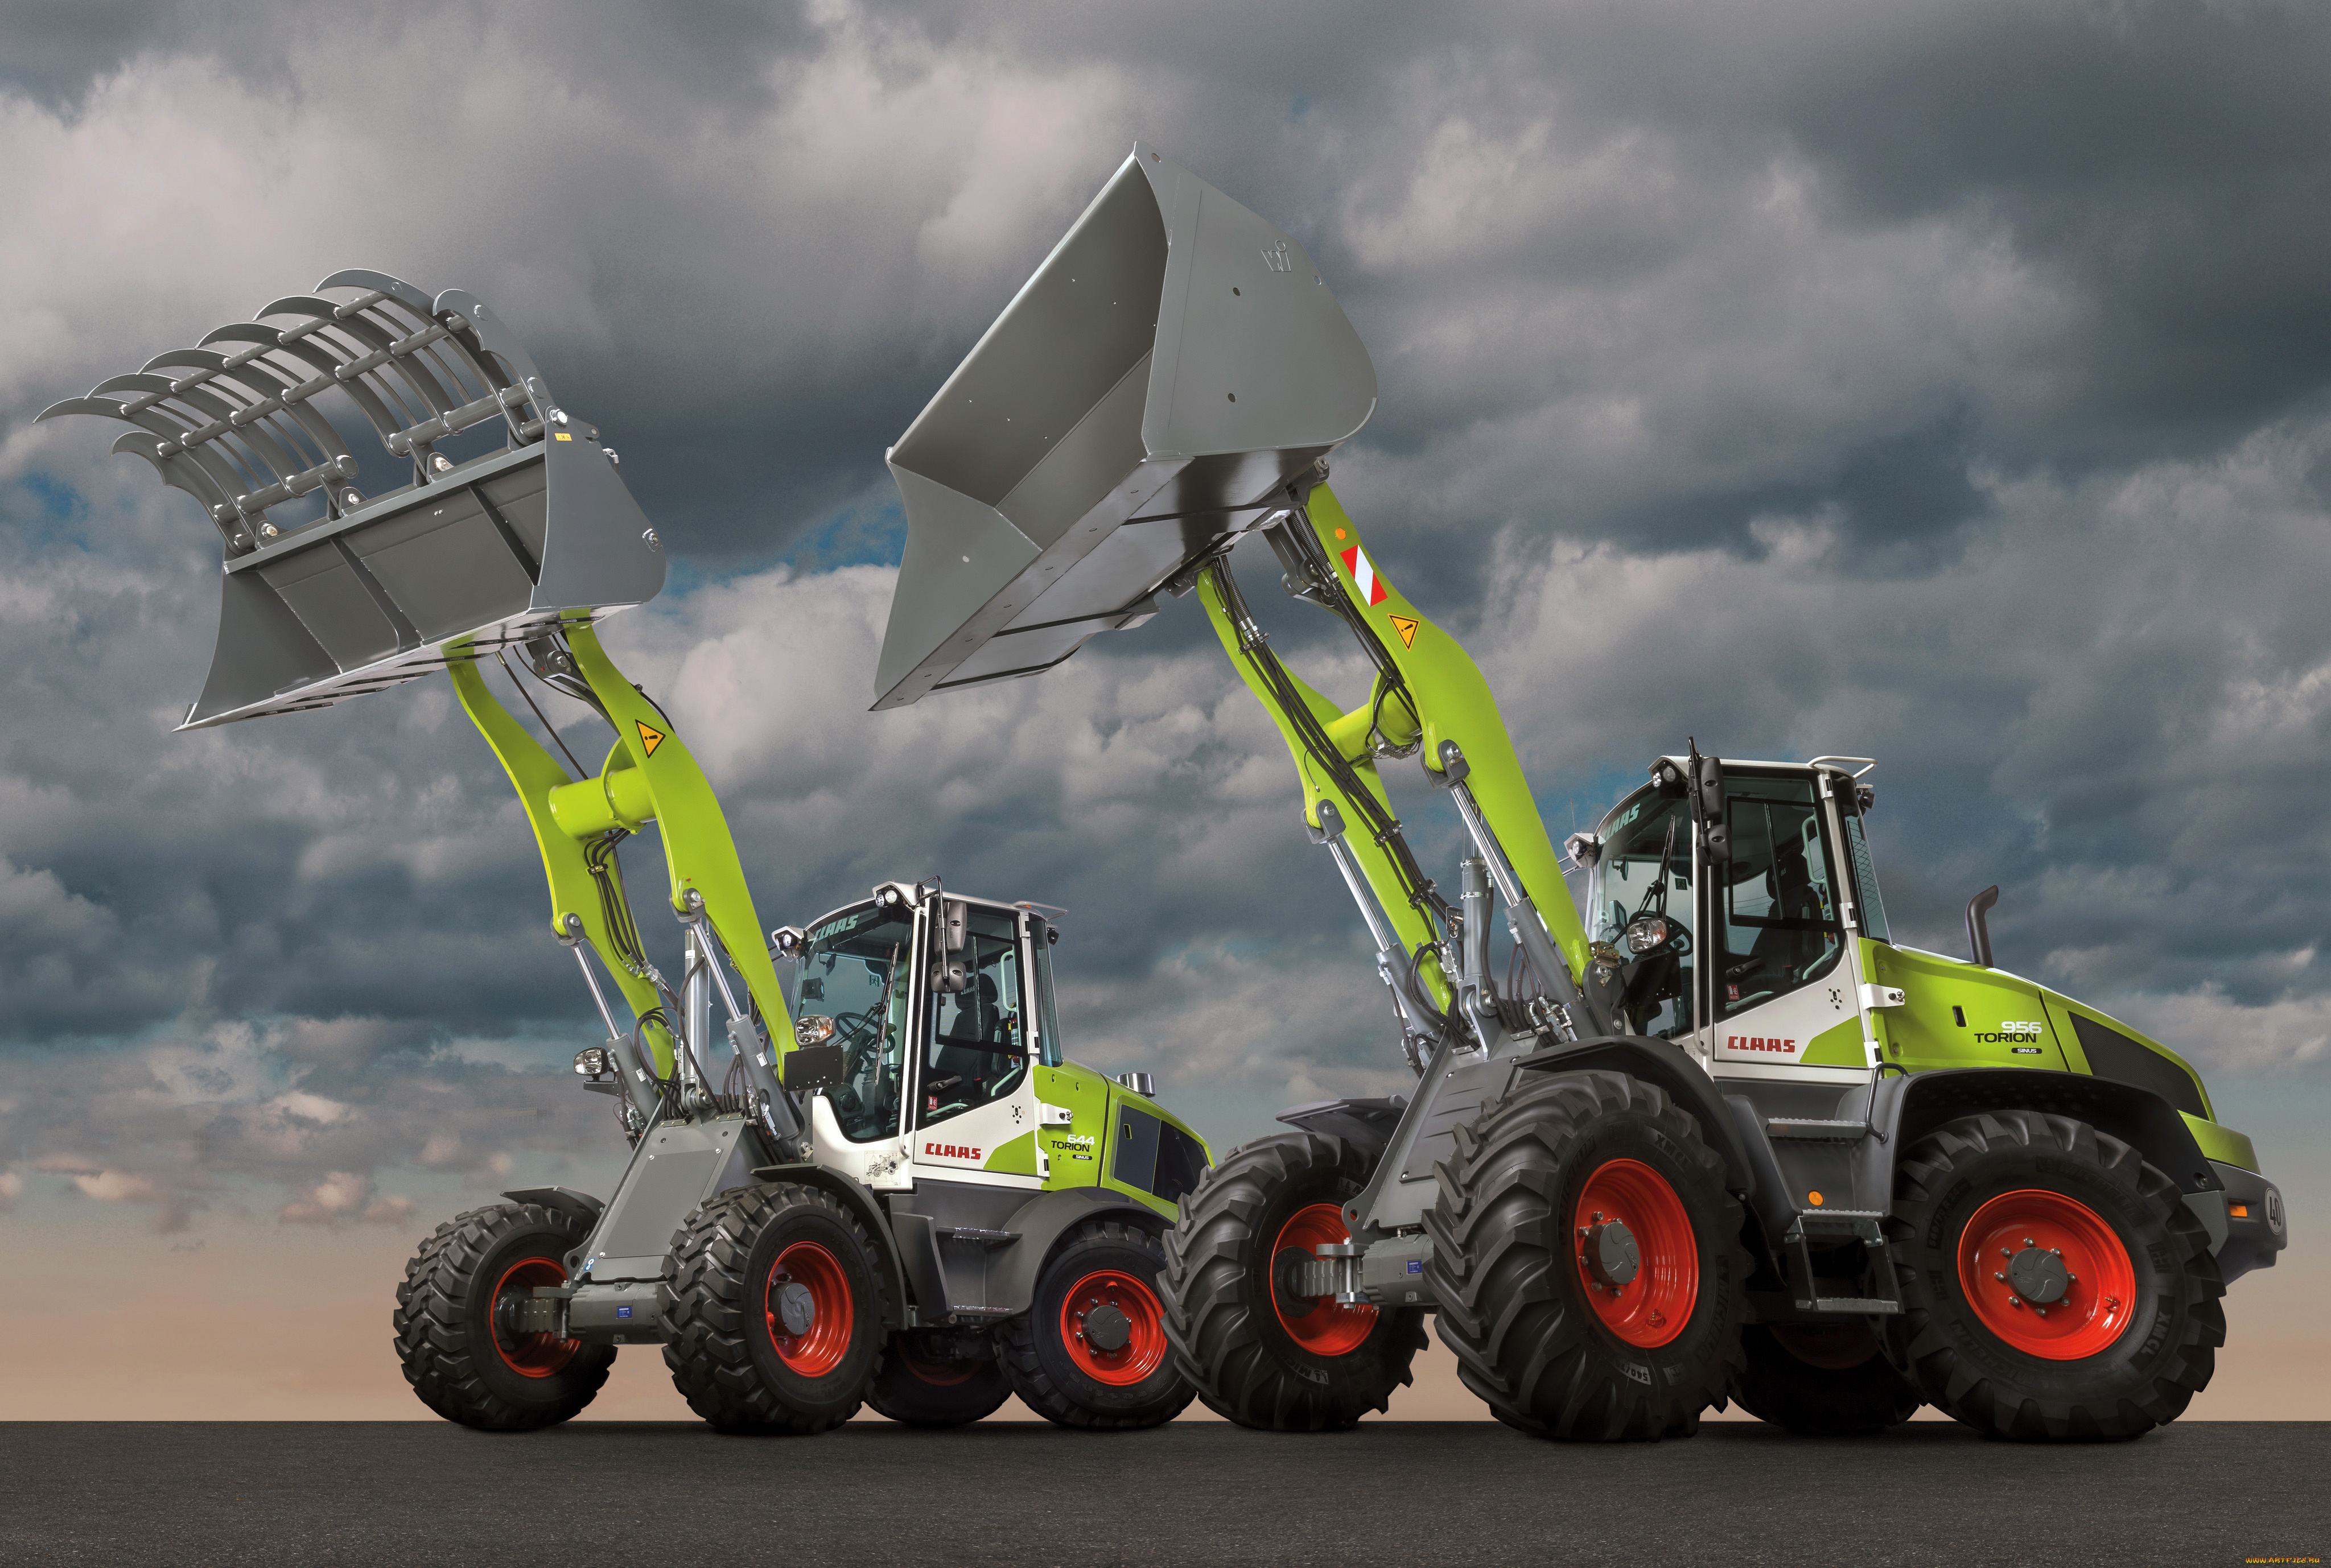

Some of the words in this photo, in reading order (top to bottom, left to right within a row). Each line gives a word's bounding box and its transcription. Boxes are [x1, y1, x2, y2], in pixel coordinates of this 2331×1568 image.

[814, 914, 859, 943] CLAAS
[2001, 1021, 2042, 1034] 956
[1728, 1036, 1795, 1053] CLAAS
[1974, 1032, 2037, 1043] TORION
[1051, 1140, 1090, 1152] TORION
[1067, 1134, 1095, 1145] 644
[925, 1142, 981, 1160] CLAAS
[2269, 1196, 2281, 1226] 40
[2140, 1310, 2172, 1356] XMCL
